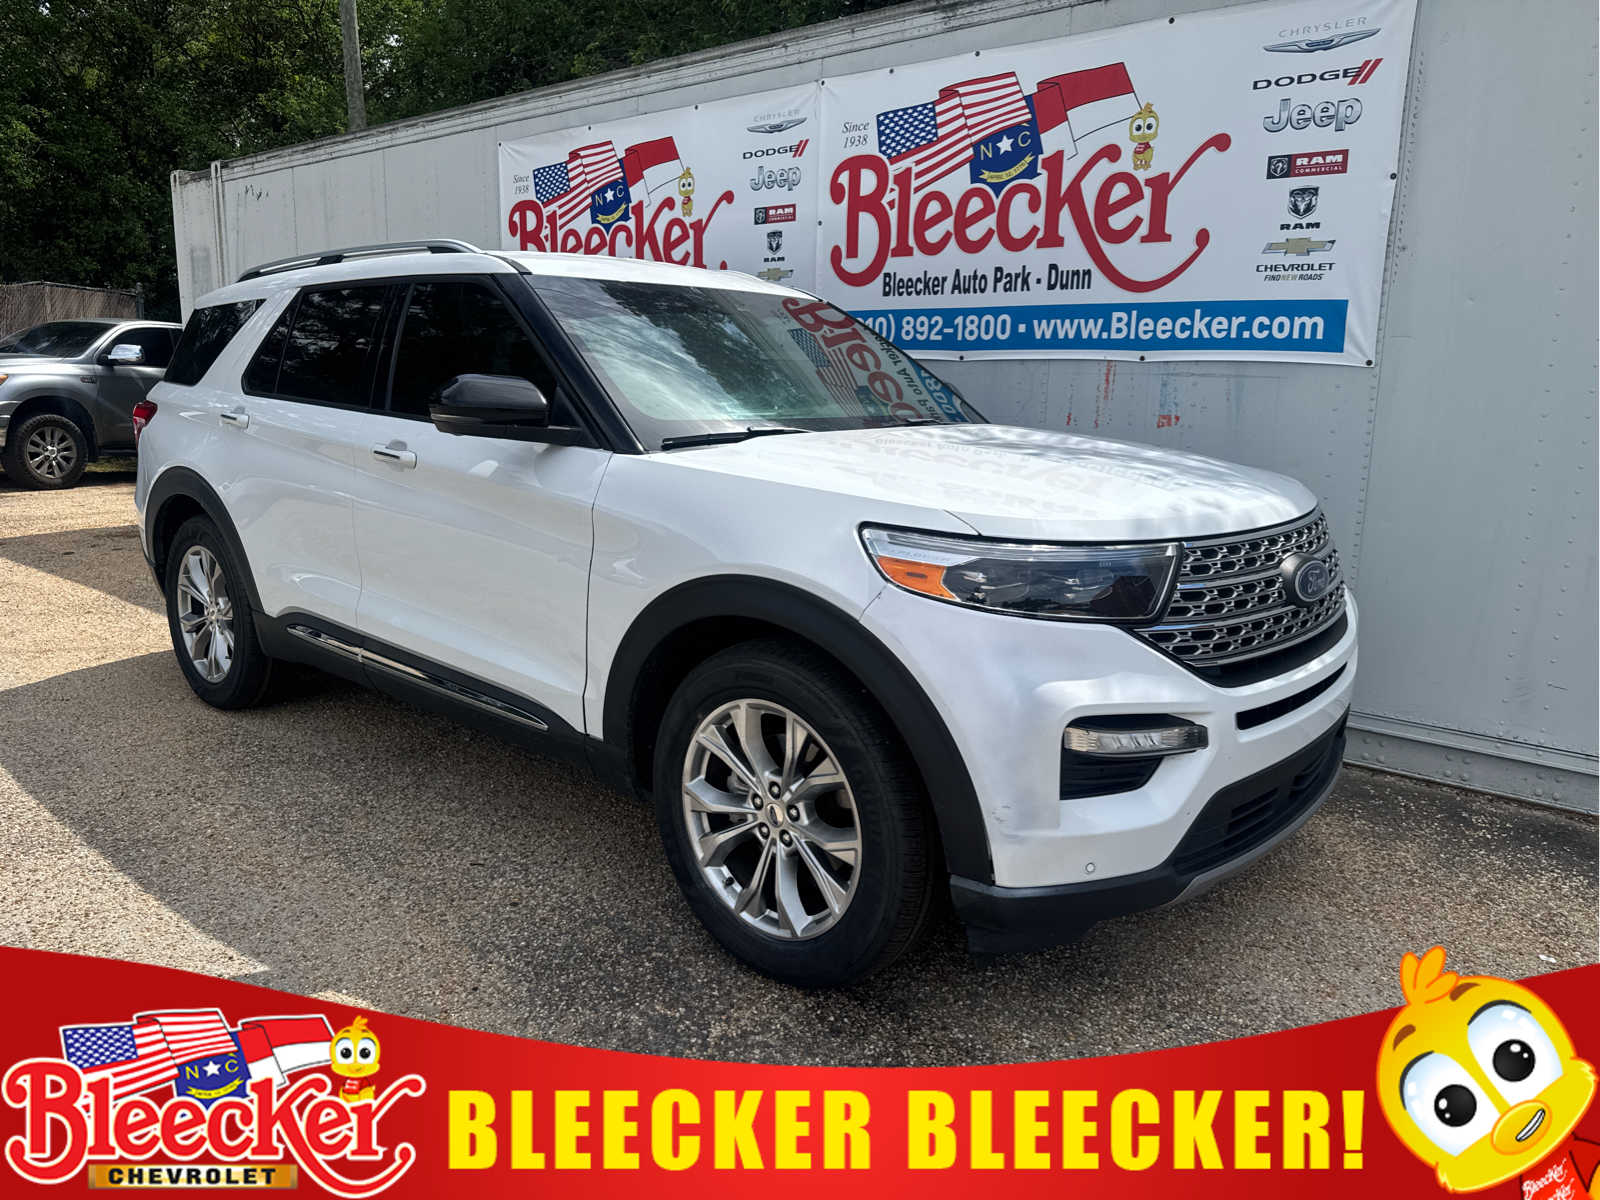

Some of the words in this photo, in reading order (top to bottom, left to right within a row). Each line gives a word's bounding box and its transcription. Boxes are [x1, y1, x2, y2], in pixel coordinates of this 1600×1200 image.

[1278, 16, 1367, 38] CHRYSLER
[1252, 66, 1362, 90] DODGE
[1263, 98, 1362, 132] Jeep
[842, 121, 870, 134] Since
[743, 143, 800, 159] DODGE
[843, 134, 869, 148] 1938
[1295, 154, 1343, 166] RAM
[750, 166, 801, 191] Jeep
[830, 133, 1231, 293] Bleecker
[1280, 222, 1321, 231] RAM
[1256, 262, 1336, 273] CHEVROLET
[882, 270, 948, 297] Bleecker
[951, 268, 988, 295] Auto
[993, 265, 1031, 293] Park
[1047, 263, 1092, 291] Dunn
[901, 314, 1012, 341] 892-1800
[1033, 309, 1324, 340] www.Bleecker.com
